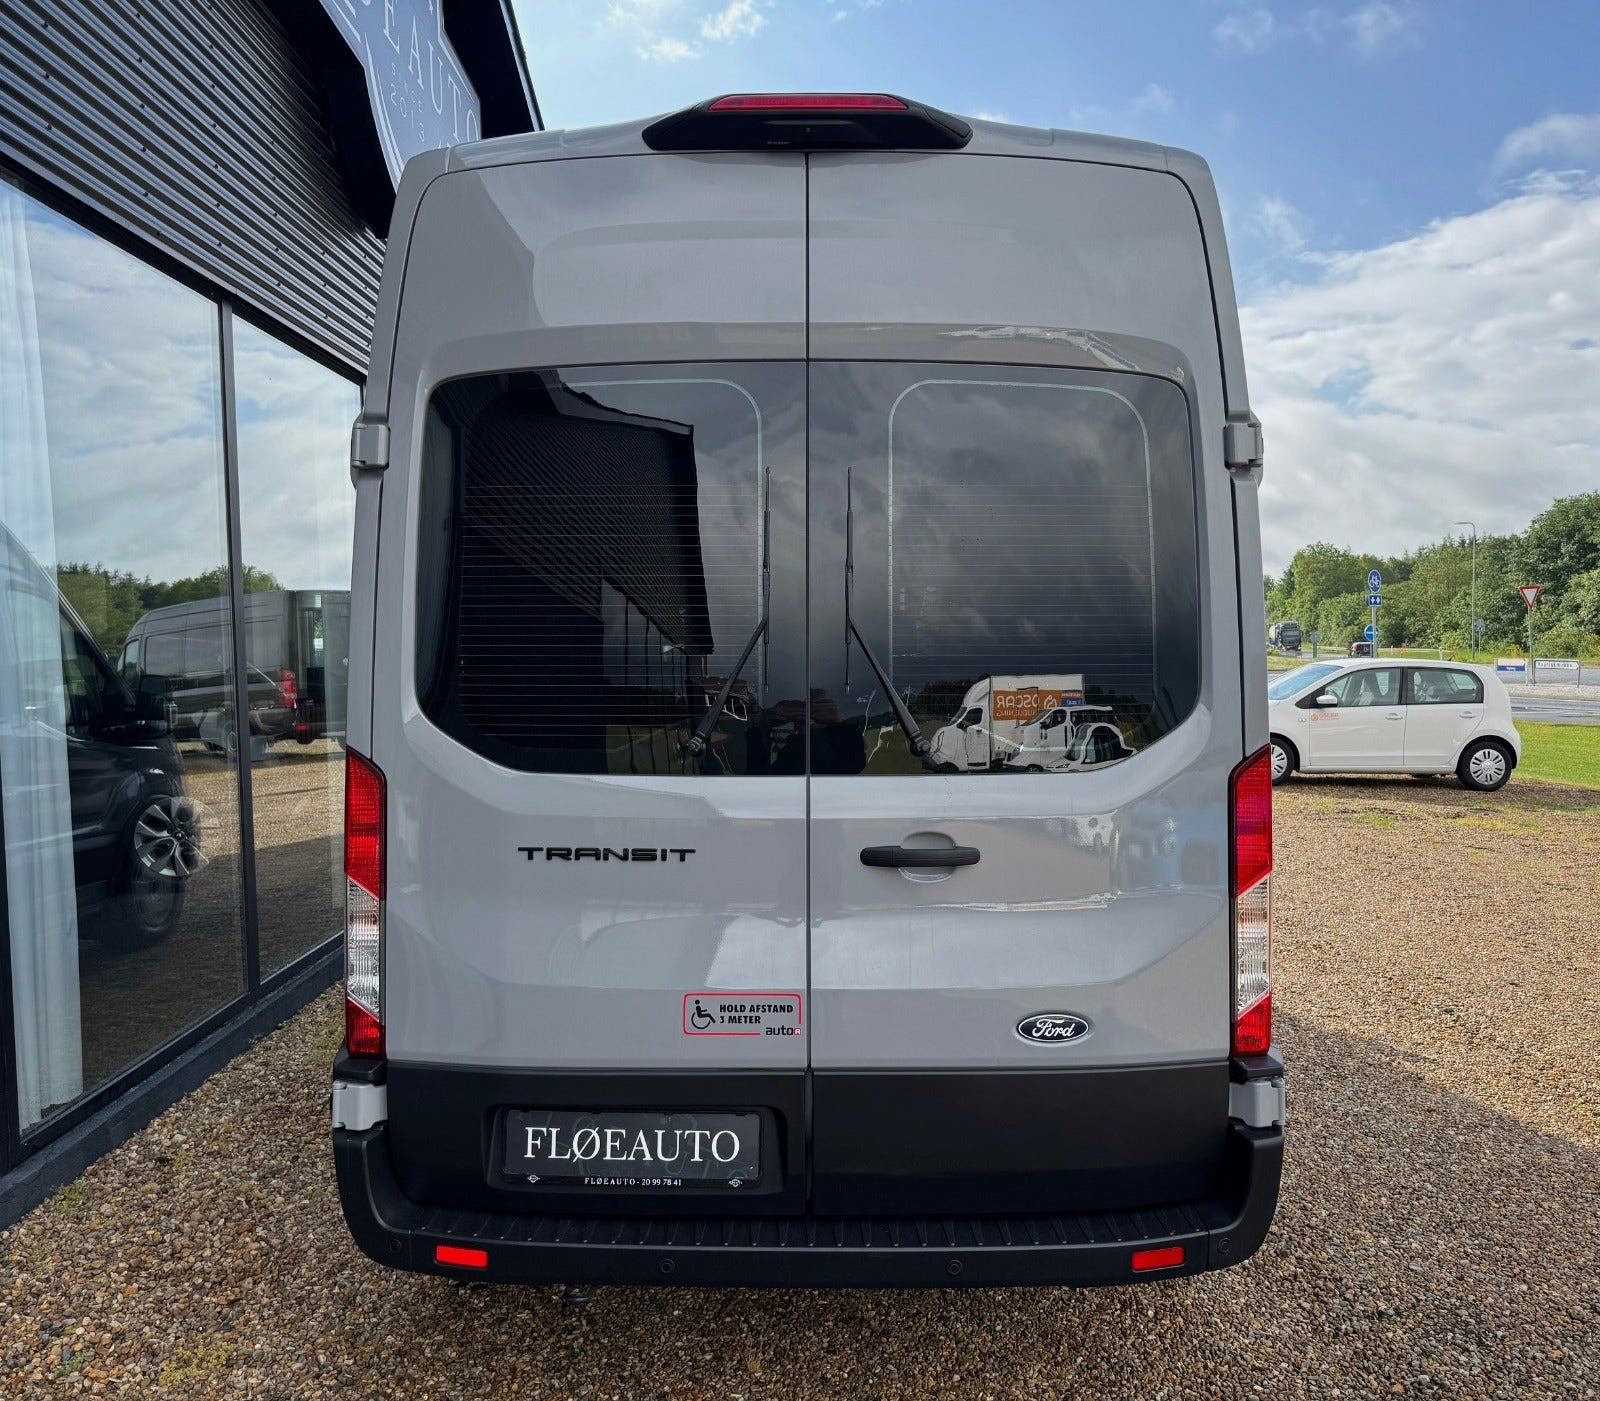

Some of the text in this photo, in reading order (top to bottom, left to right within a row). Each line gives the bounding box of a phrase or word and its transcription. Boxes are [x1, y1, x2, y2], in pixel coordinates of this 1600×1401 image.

[517, 846, 696, 862] TRANSIT
[719, 1004, 794, 1013] HOLD AFSTAND
[719, 1015, 761, 1024] 3 METER
[1031, 1018, 1076, 1037] Ford
[523, 1126, 740, 1163] FLØEAUTO
[641, 1178, 651, 1186] 20
[652, 1178, 661, 1186] 99
[662, 1178, 672, 1186] 78
[673, 1178, 682, 1186] 41
